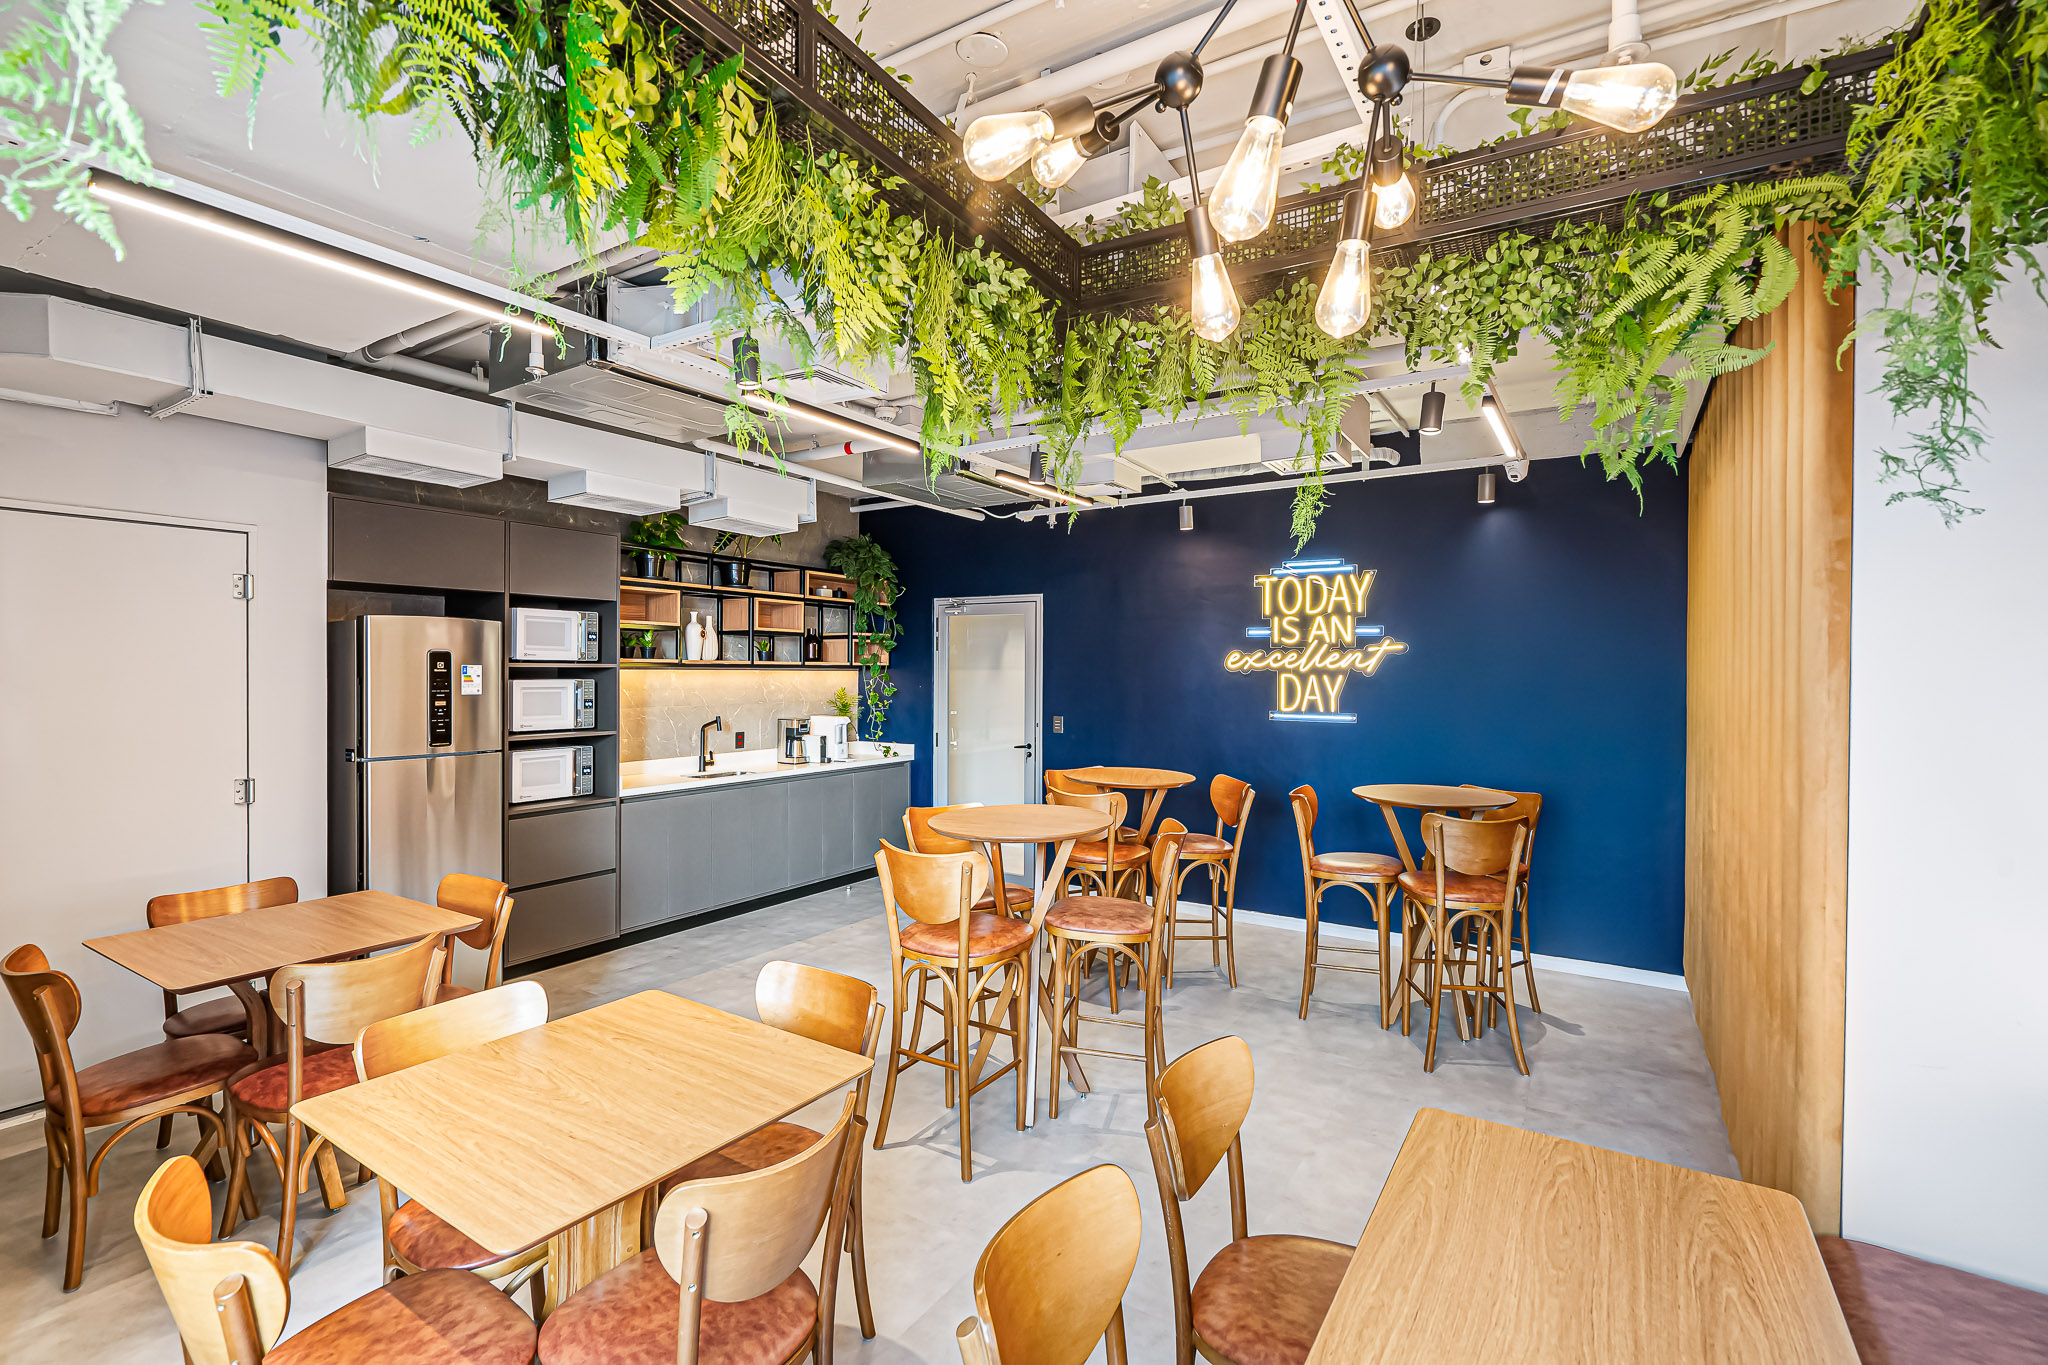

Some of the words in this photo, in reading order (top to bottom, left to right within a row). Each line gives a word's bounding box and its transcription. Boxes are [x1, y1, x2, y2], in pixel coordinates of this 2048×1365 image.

[1257, 573, 1371, 616] TODAY
[1272, 615, 1301, 644] IS
[1308, 614, 1352, 644] AN
[1227, 639, 1405, 673] excellent
[1279, 673, 1344, 713] DAY
